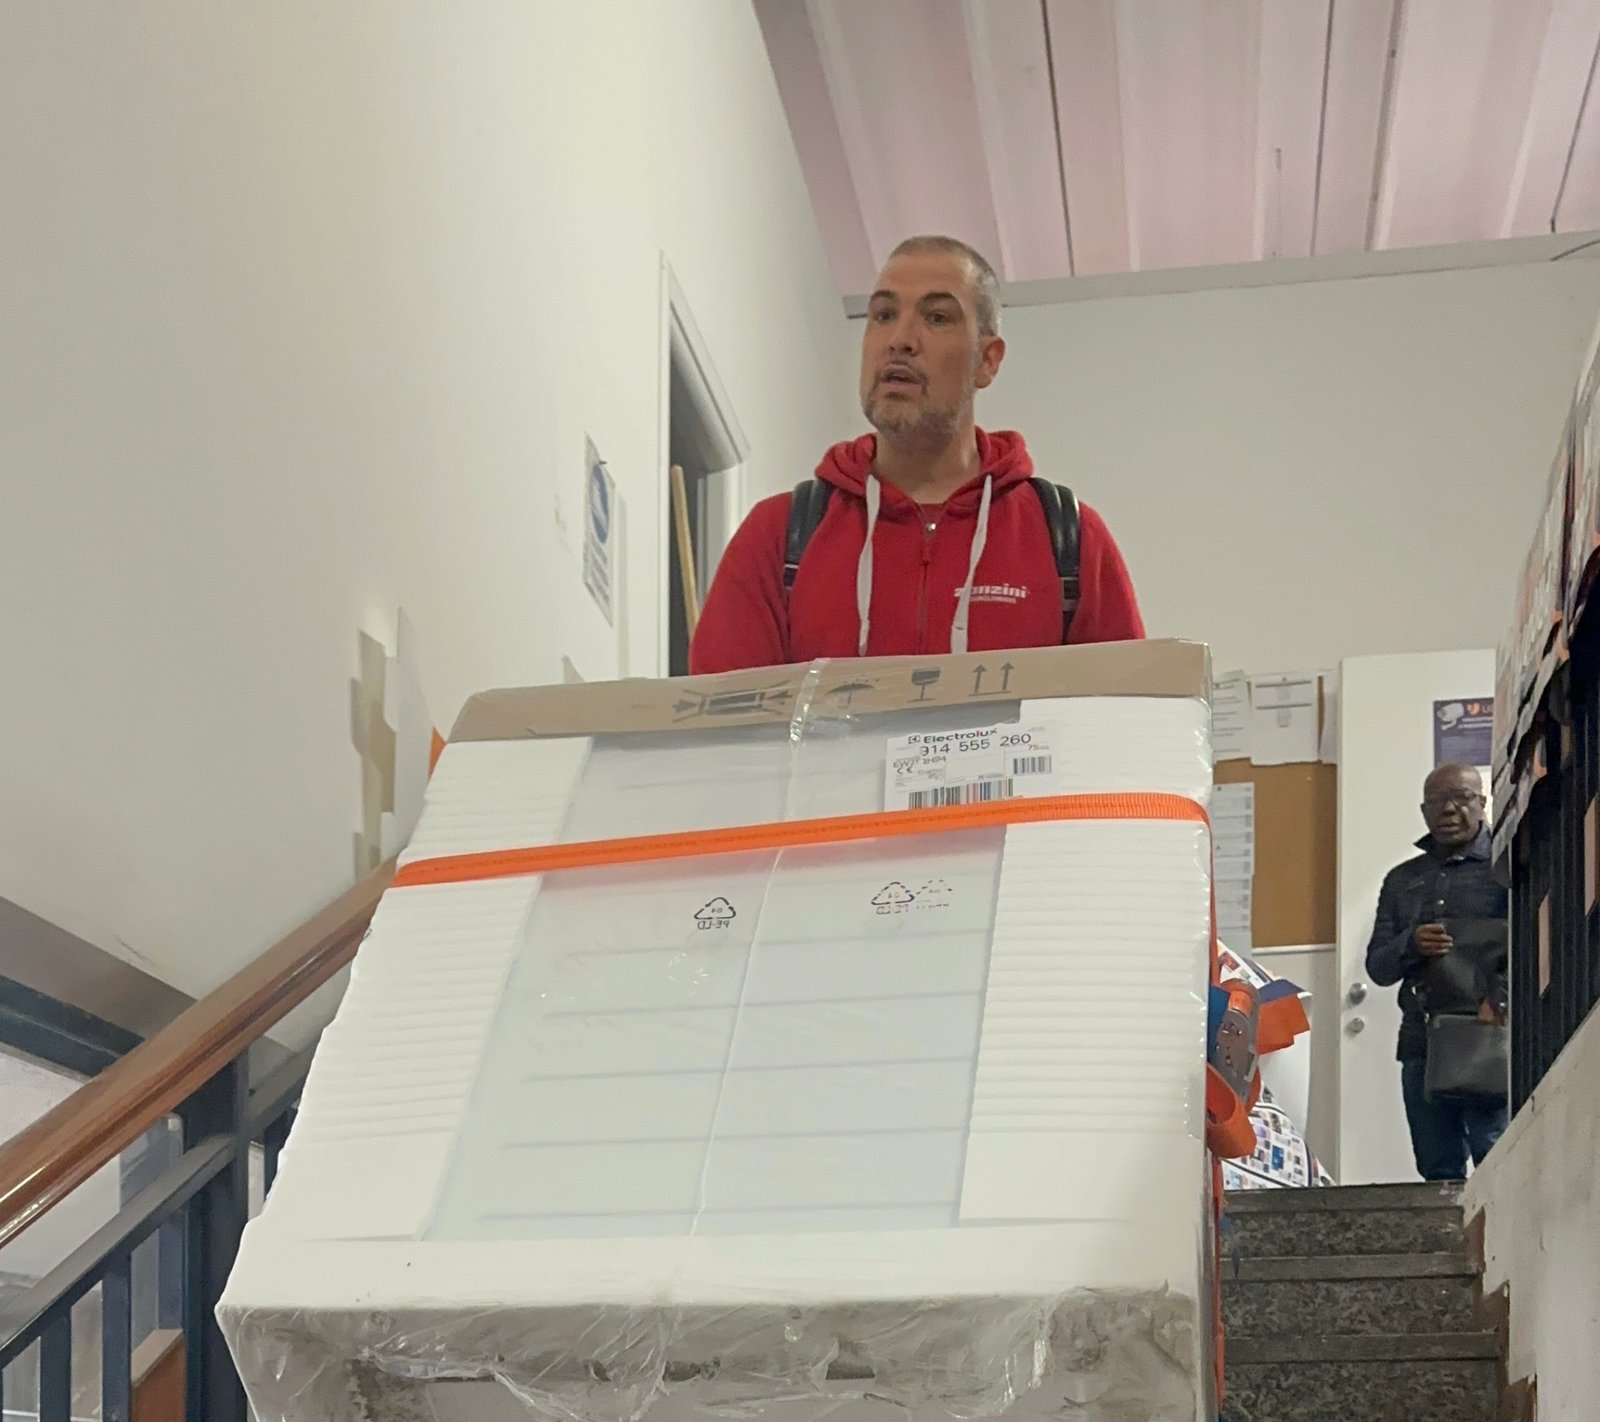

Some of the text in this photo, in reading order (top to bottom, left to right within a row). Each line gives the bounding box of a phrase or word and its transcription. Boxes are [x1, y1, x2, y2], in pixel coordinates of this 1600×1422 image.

[923, 728, 998, 744] Electrolux
[959, 739, 990, 752] 555
[1000, 733, 1031, 747] 260
